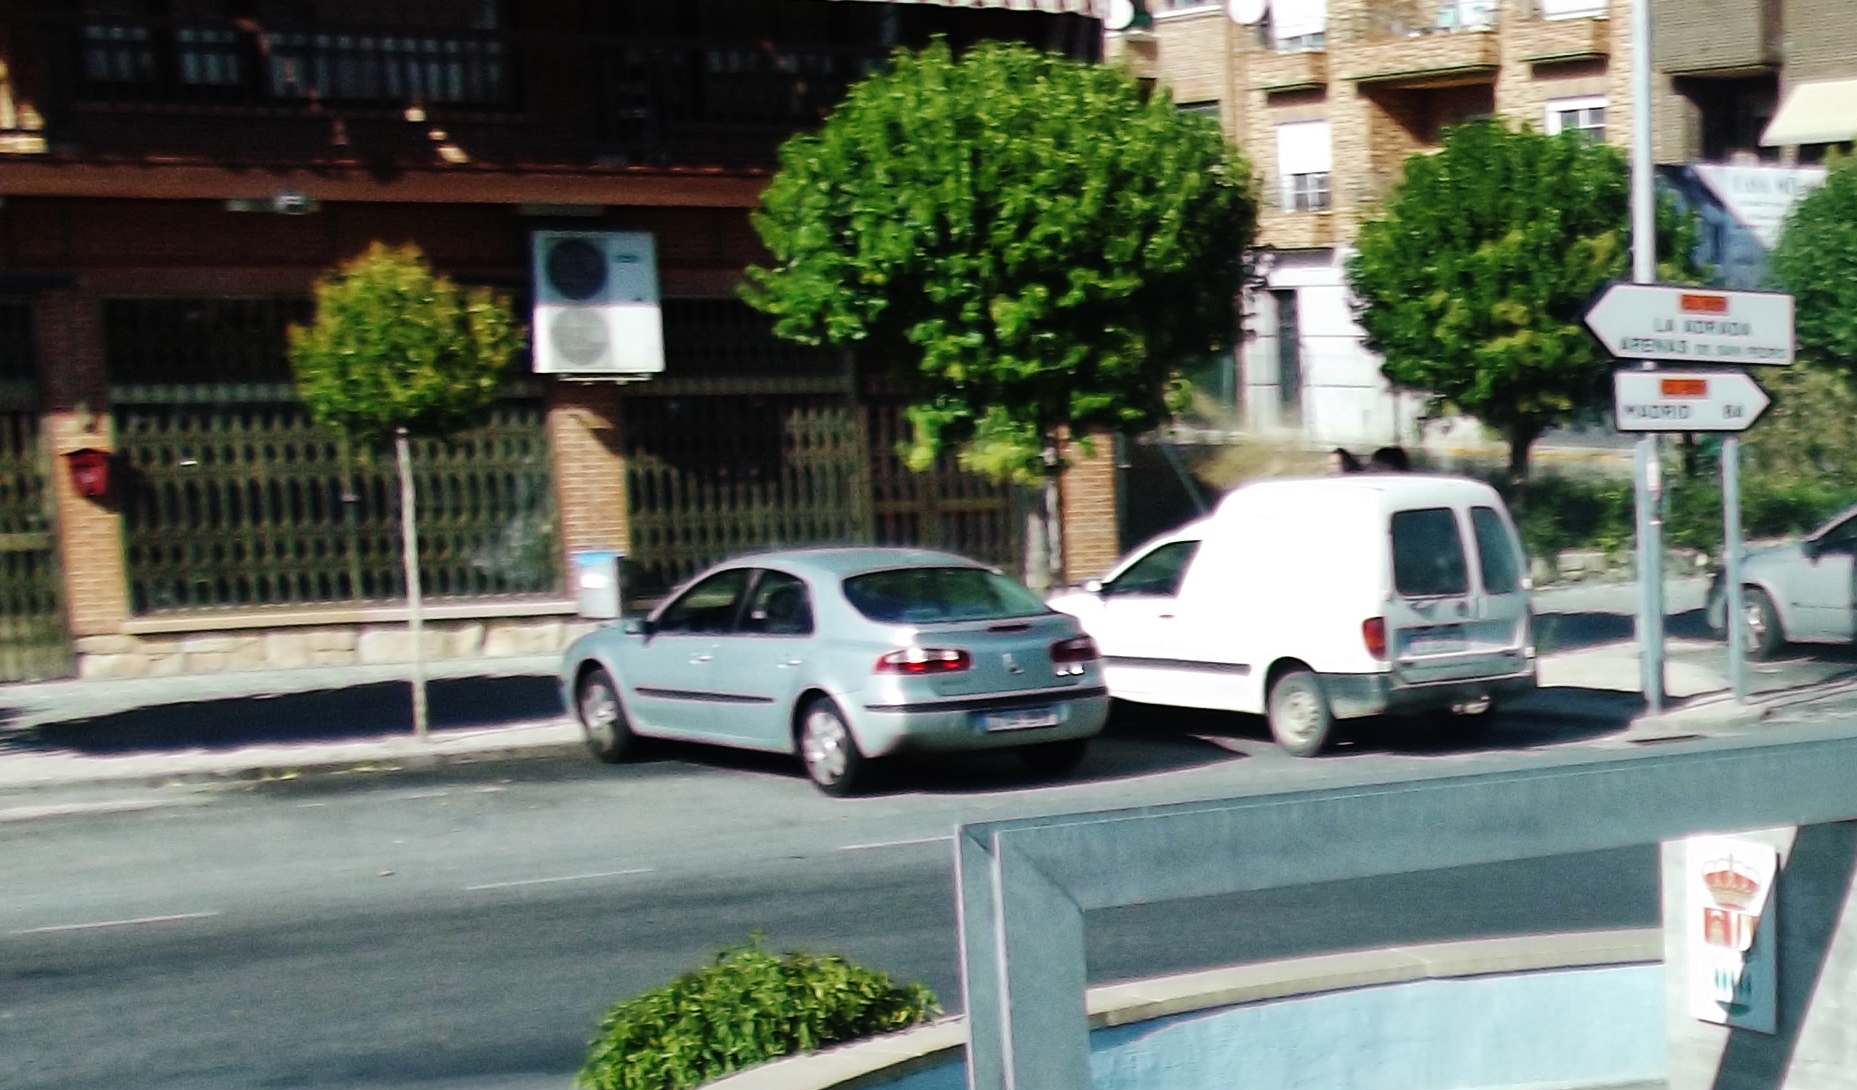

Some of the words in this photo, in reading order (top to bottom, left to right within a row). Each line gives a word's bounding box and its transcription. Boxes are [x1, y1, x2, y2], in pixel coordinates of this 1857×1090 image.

[1653, 318, 1675, 333] LA
[1683, 320, 1752, 336] ADRADA
[1619, 337, 1688, 354] ARENAS
[1623, 404, 1692, 420] MADRID
